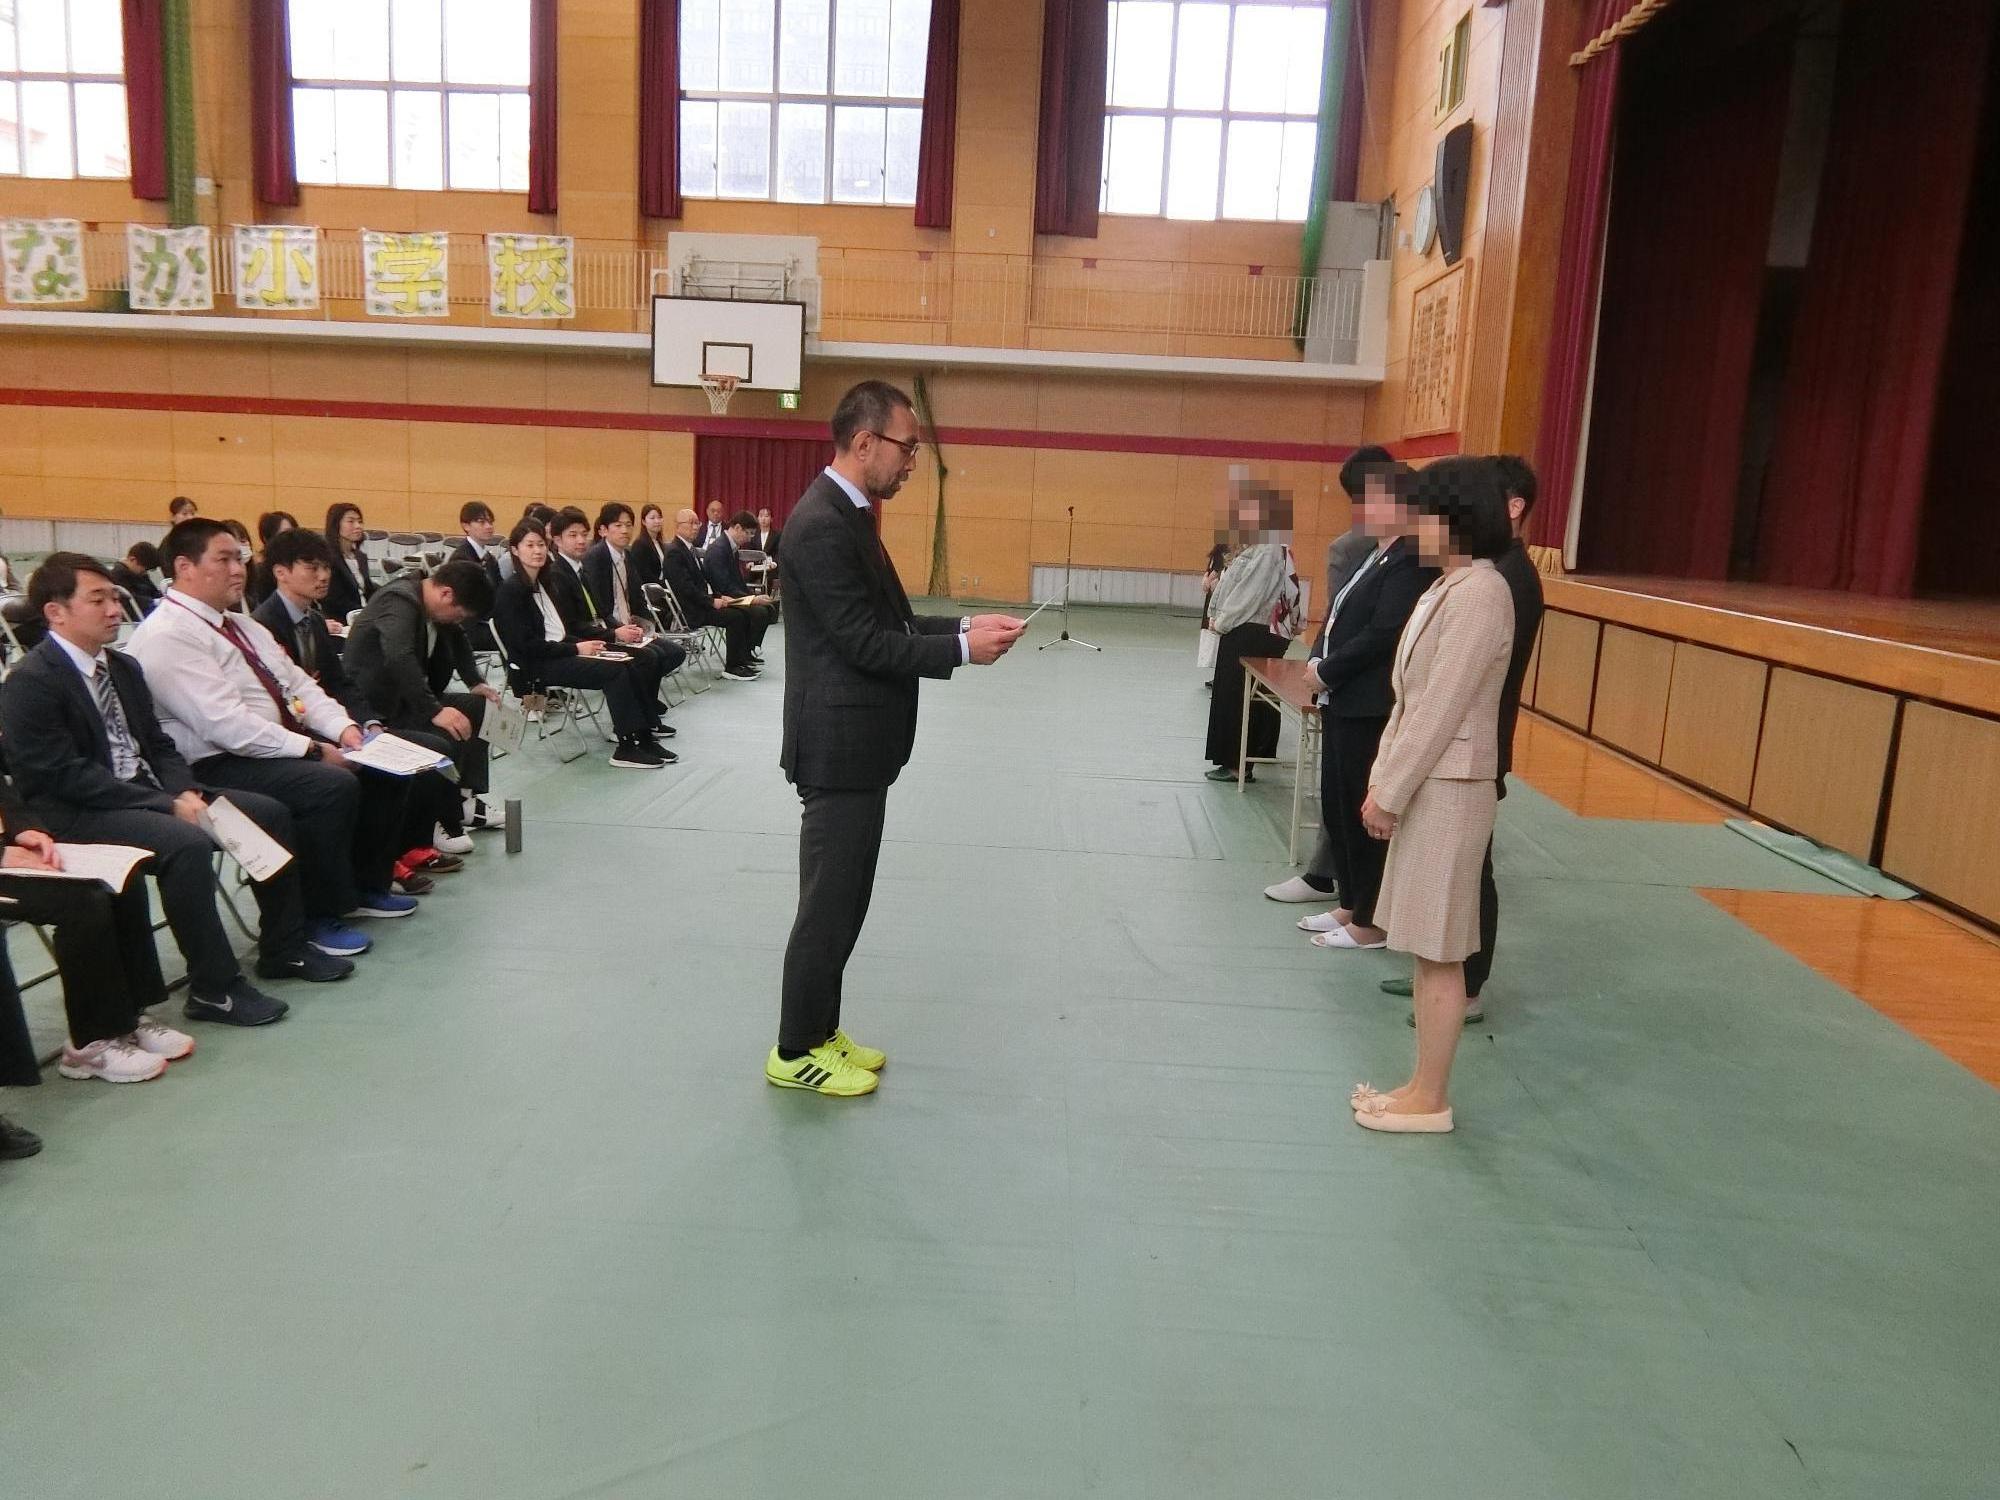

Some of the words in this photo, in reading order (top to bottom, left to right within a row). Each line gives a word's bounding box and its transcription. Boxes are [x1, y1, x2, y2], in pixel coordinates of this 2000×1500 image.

[8, 224, 572, 316] なか小学校
